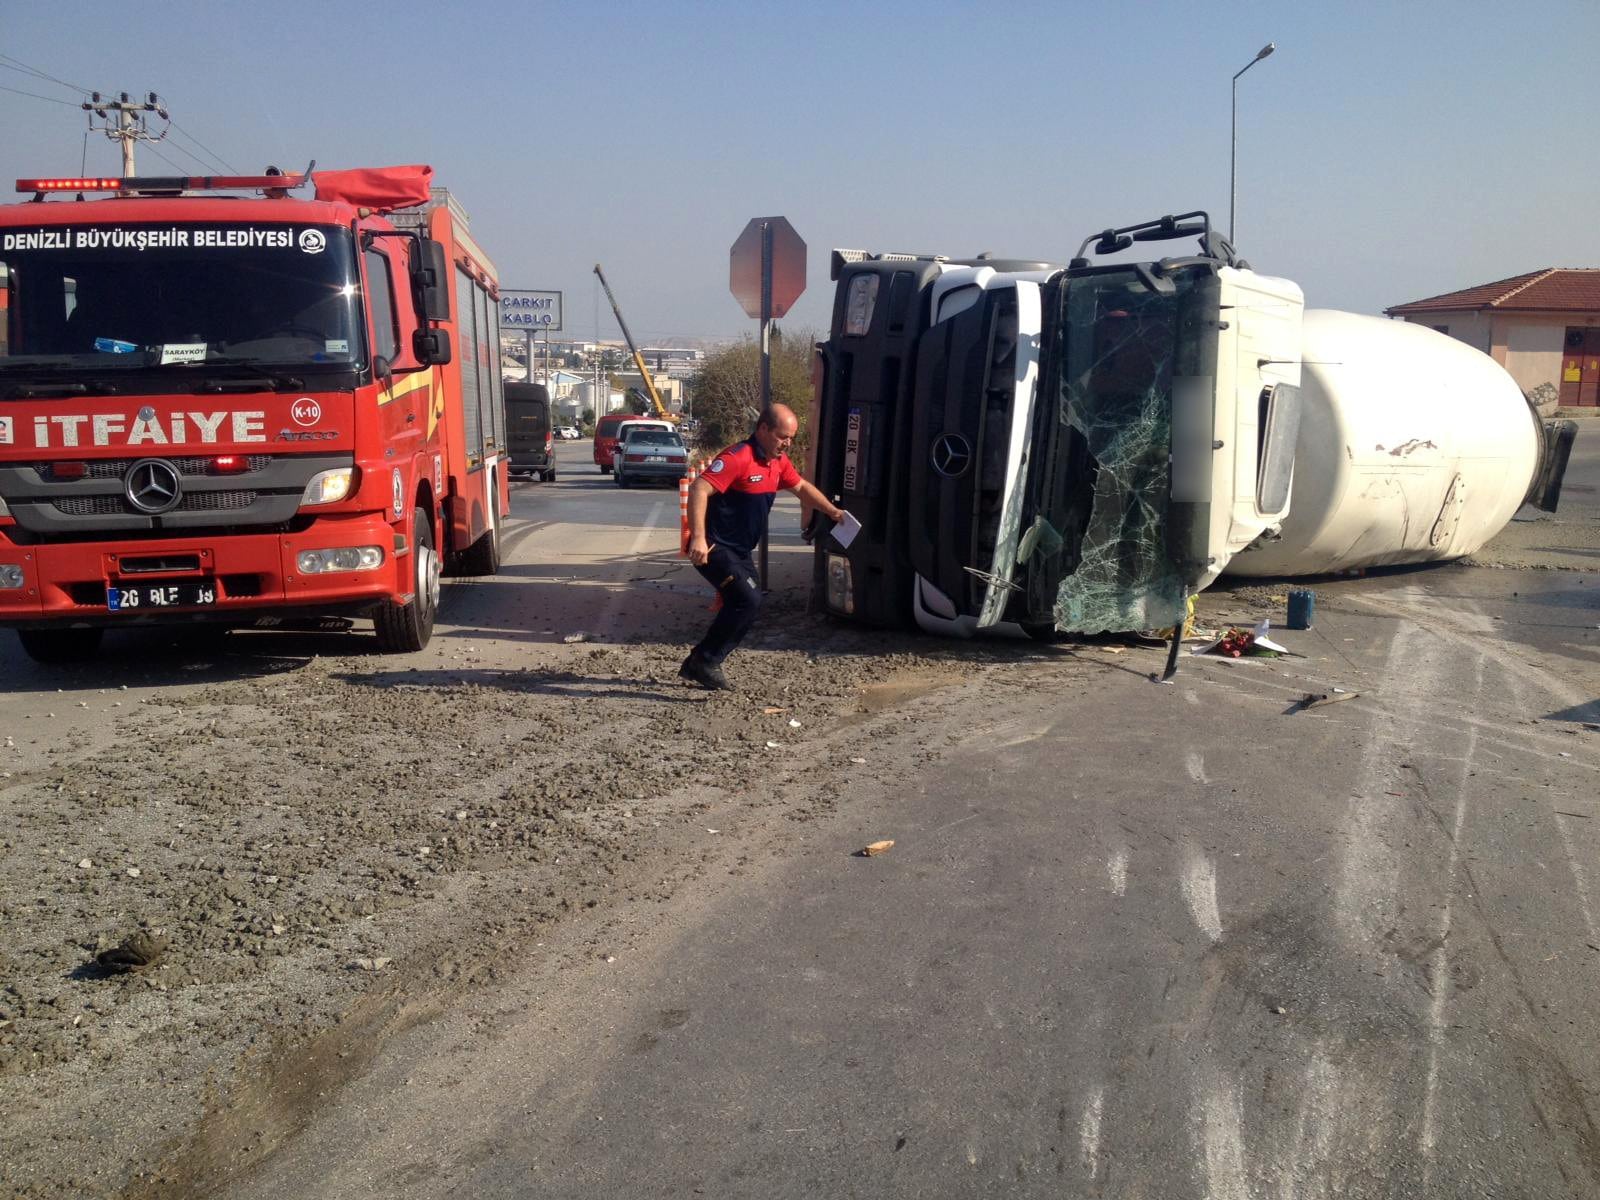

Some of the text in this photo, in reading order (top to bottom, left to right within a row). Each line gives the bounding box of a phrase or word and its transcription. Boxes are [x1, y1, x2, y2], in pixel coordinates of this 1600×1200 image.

[4, 227, 294, 251] DENİZLİ BÜYÜKŞEHİR BELEDİYESİ
[504, 312, 553, 325] KABLO
[295, 406, 318, 418] K-10
[848, 415, 859, 430] 20
[844, 465, 856, 489] 500
